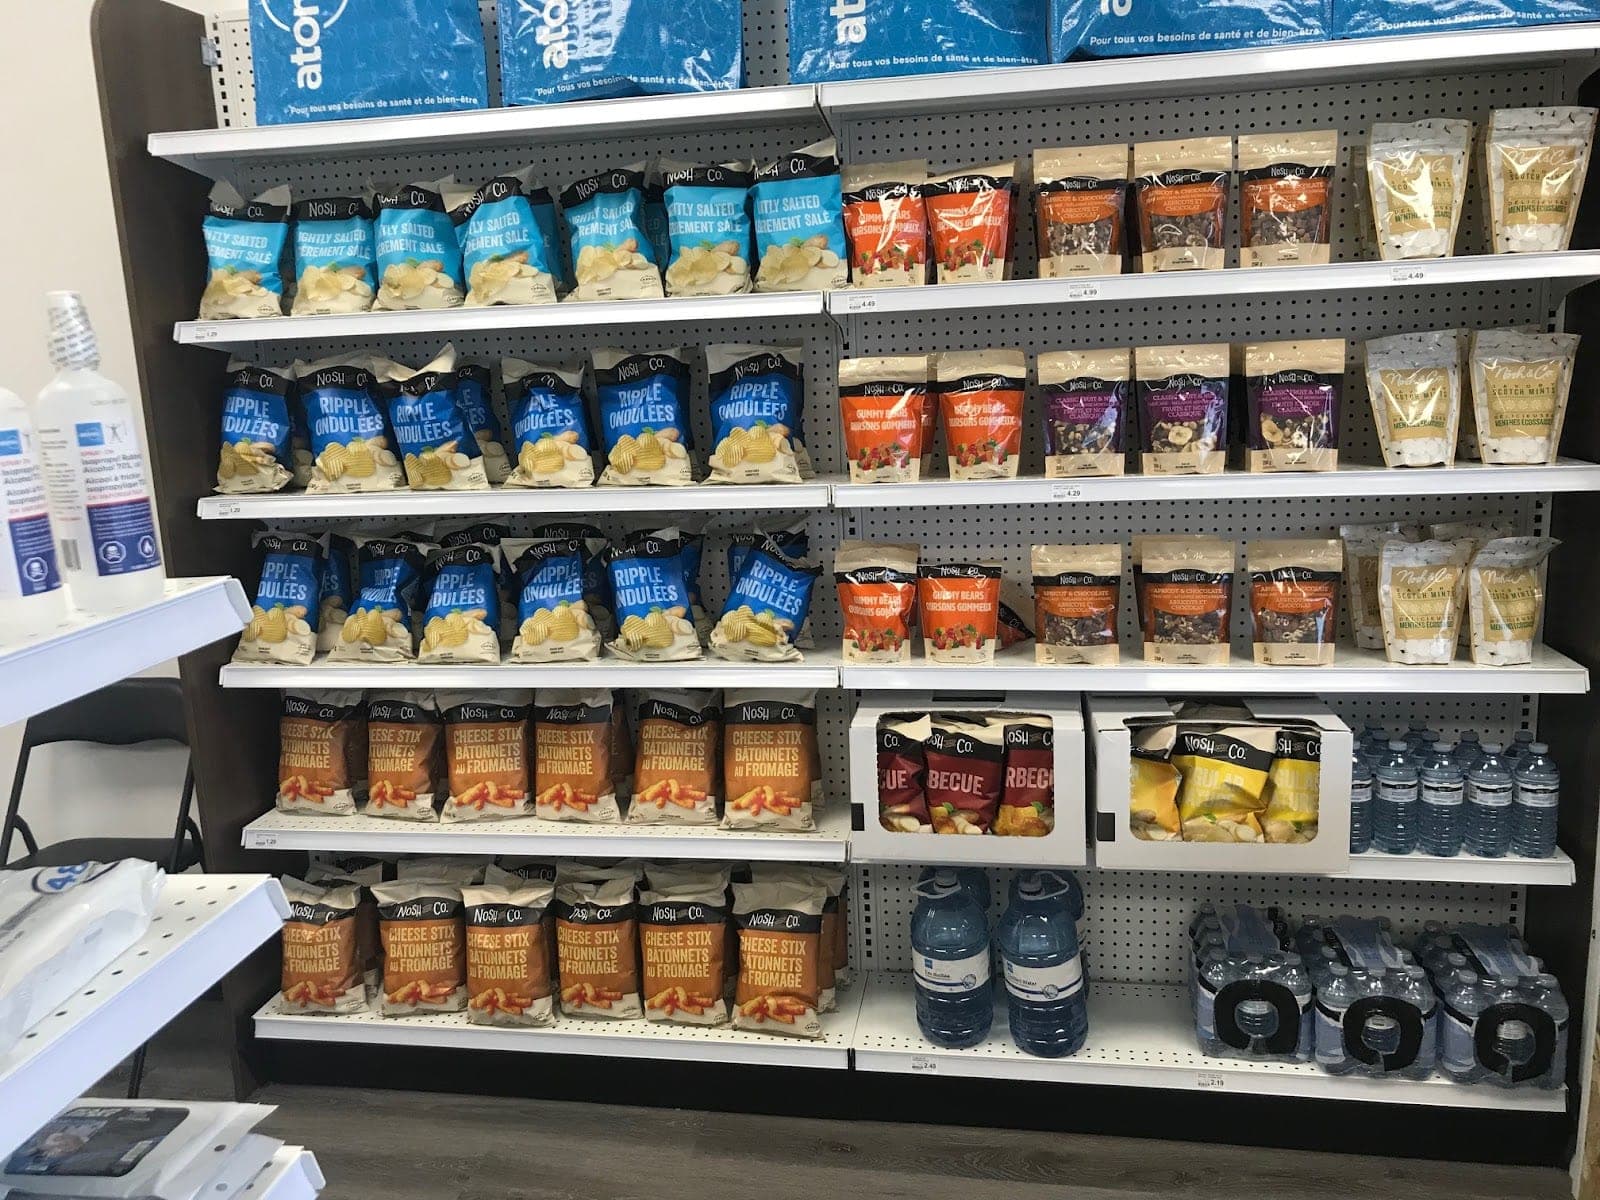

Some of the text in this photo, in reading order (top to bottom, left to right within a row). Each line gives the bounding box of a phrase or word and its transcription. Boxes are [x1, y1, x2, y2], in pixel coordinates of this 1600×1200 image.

[1379, 22, 1403, 31] Pour
[1433, 17, 1451, 25] vos
[1090, 36, 1111, 46] Pour
[1114, 35, 1135, 44] tous
[1138, 34, 1154, 43] vos
[1157, 32, 1195, 42] besoins
[1199, 32, 1211, 40] de
[1214, 31, 1241, 40] santé
[1257, 29, 1269, 38] de
[829, 60, 850, 70] Pour
[853, 58, 873, 68] tous
[875, 57, 891, 66] vos
[893, 55, 928, 65] besoins
[932, 54, 942, 62] de
[946, 53, 969, 63] santé
[983, 55, 994, 63] de
[537, 74, 676, 97] Pour tous vos de santé et
[290, 106, 308, 116] Pour
[310, 105, 326, 113] tous
[343, 100, 375, 110] besoins
[377, 99, 388, 108] de
[390, 97, 412, 107] santé
[415, 97, 423, 105] et
[425, 96, 435, 104] de
[308, 201, 337, 217] NOSH
[603, 201, 635, 220] SALTED
[696, 201, 735, 218] SALTED
[781, 195, 820, 212] SALTED
[486, 211, 520, 233] SALTED
[334, 229, 366, 243] SALTED
[401, 224, 434, 240] SALTED
[239, 234, 268, 248] SALTED
[316, 371, 345, 386] NOSH
[618, 363, 639, 381] NOSH
[618, 383, 661, 407] RIPPLE
[730, 381, 779, 401] RIPPLE
[226, 396, 270, 418] RIPPLE
[320, 396, 368, 416] RIPPLE
[396, 402, 434, 423] RIPPLE
[719, 398, 787, 420] ONDULÉES
[609, 402, 674, 429] ONDULÉES
[316, 413, 384, 436] ONDULÉES
[614, 566, 662, 588] RIPPLE
[749, 559, 798, 591] RIPPLE
[1060, 575, 1076, 585] NOSH
[1172, 573, 1189, 583] NOSH
[736, 578, 803, 616] ONDULÉES
[961, 591, 985, 600] BEARS
[286, 700, 309, 715] NOSH
[461, 707, 488, 720] NOSH
[653, 702, 678, 719] NOSH
[742, 705, 770, 720] NOSH
[310, 726, 335, 740] STIX
[397, 729, 423, 743] STIX
[453, 727, 523, 743] CHEESE STIX
[537, 730, 594, 744] CHEESE STIX
[733, 730, 802, 746] CHEESE STIX
[884, 734, 900, 748] Co.
[956, 739, 974, 753] Co.
[1185, 735, 1247, 760] NOSH Co.
[285, 755, 331, 769] FROMAGE
[467, 759, 521, 775] FROMAGE
[546, 760, 593, 775] FROMAGE
[651, 756, 705, 772] FROMAGE
[734, 762, 799, 777] AU FROMAGE
[929, 770, 985, 796] BECUE
[397, 903, 422, 918] NOSH
[474, 909, 499, 924] NOSH
[652, 906, 677, 921] NOSH
[749, 913, 776, 928] NOSH
[316, 927, 341, 941] STIX
[389, 925, 455, 941] CHEESE STIX
[468, 933, 530, 949] CHEESE STIX
[558, 926, 620, 944] CHEESE STIX
[645, 930, 712, 946] CHEESE STIX
[780, 939, 807, 955] STIX
[289, 959, 340, 973] FROMAGE
[401, 957, 454, 972] FROMAGE
[478, 964, 528, 980] FROMAGE
[566, 960, 618, 975] FROMAGE
[647, 963, 710, 978] AU FROMAGE
[748, 972, 802, 988] FROMAGE
